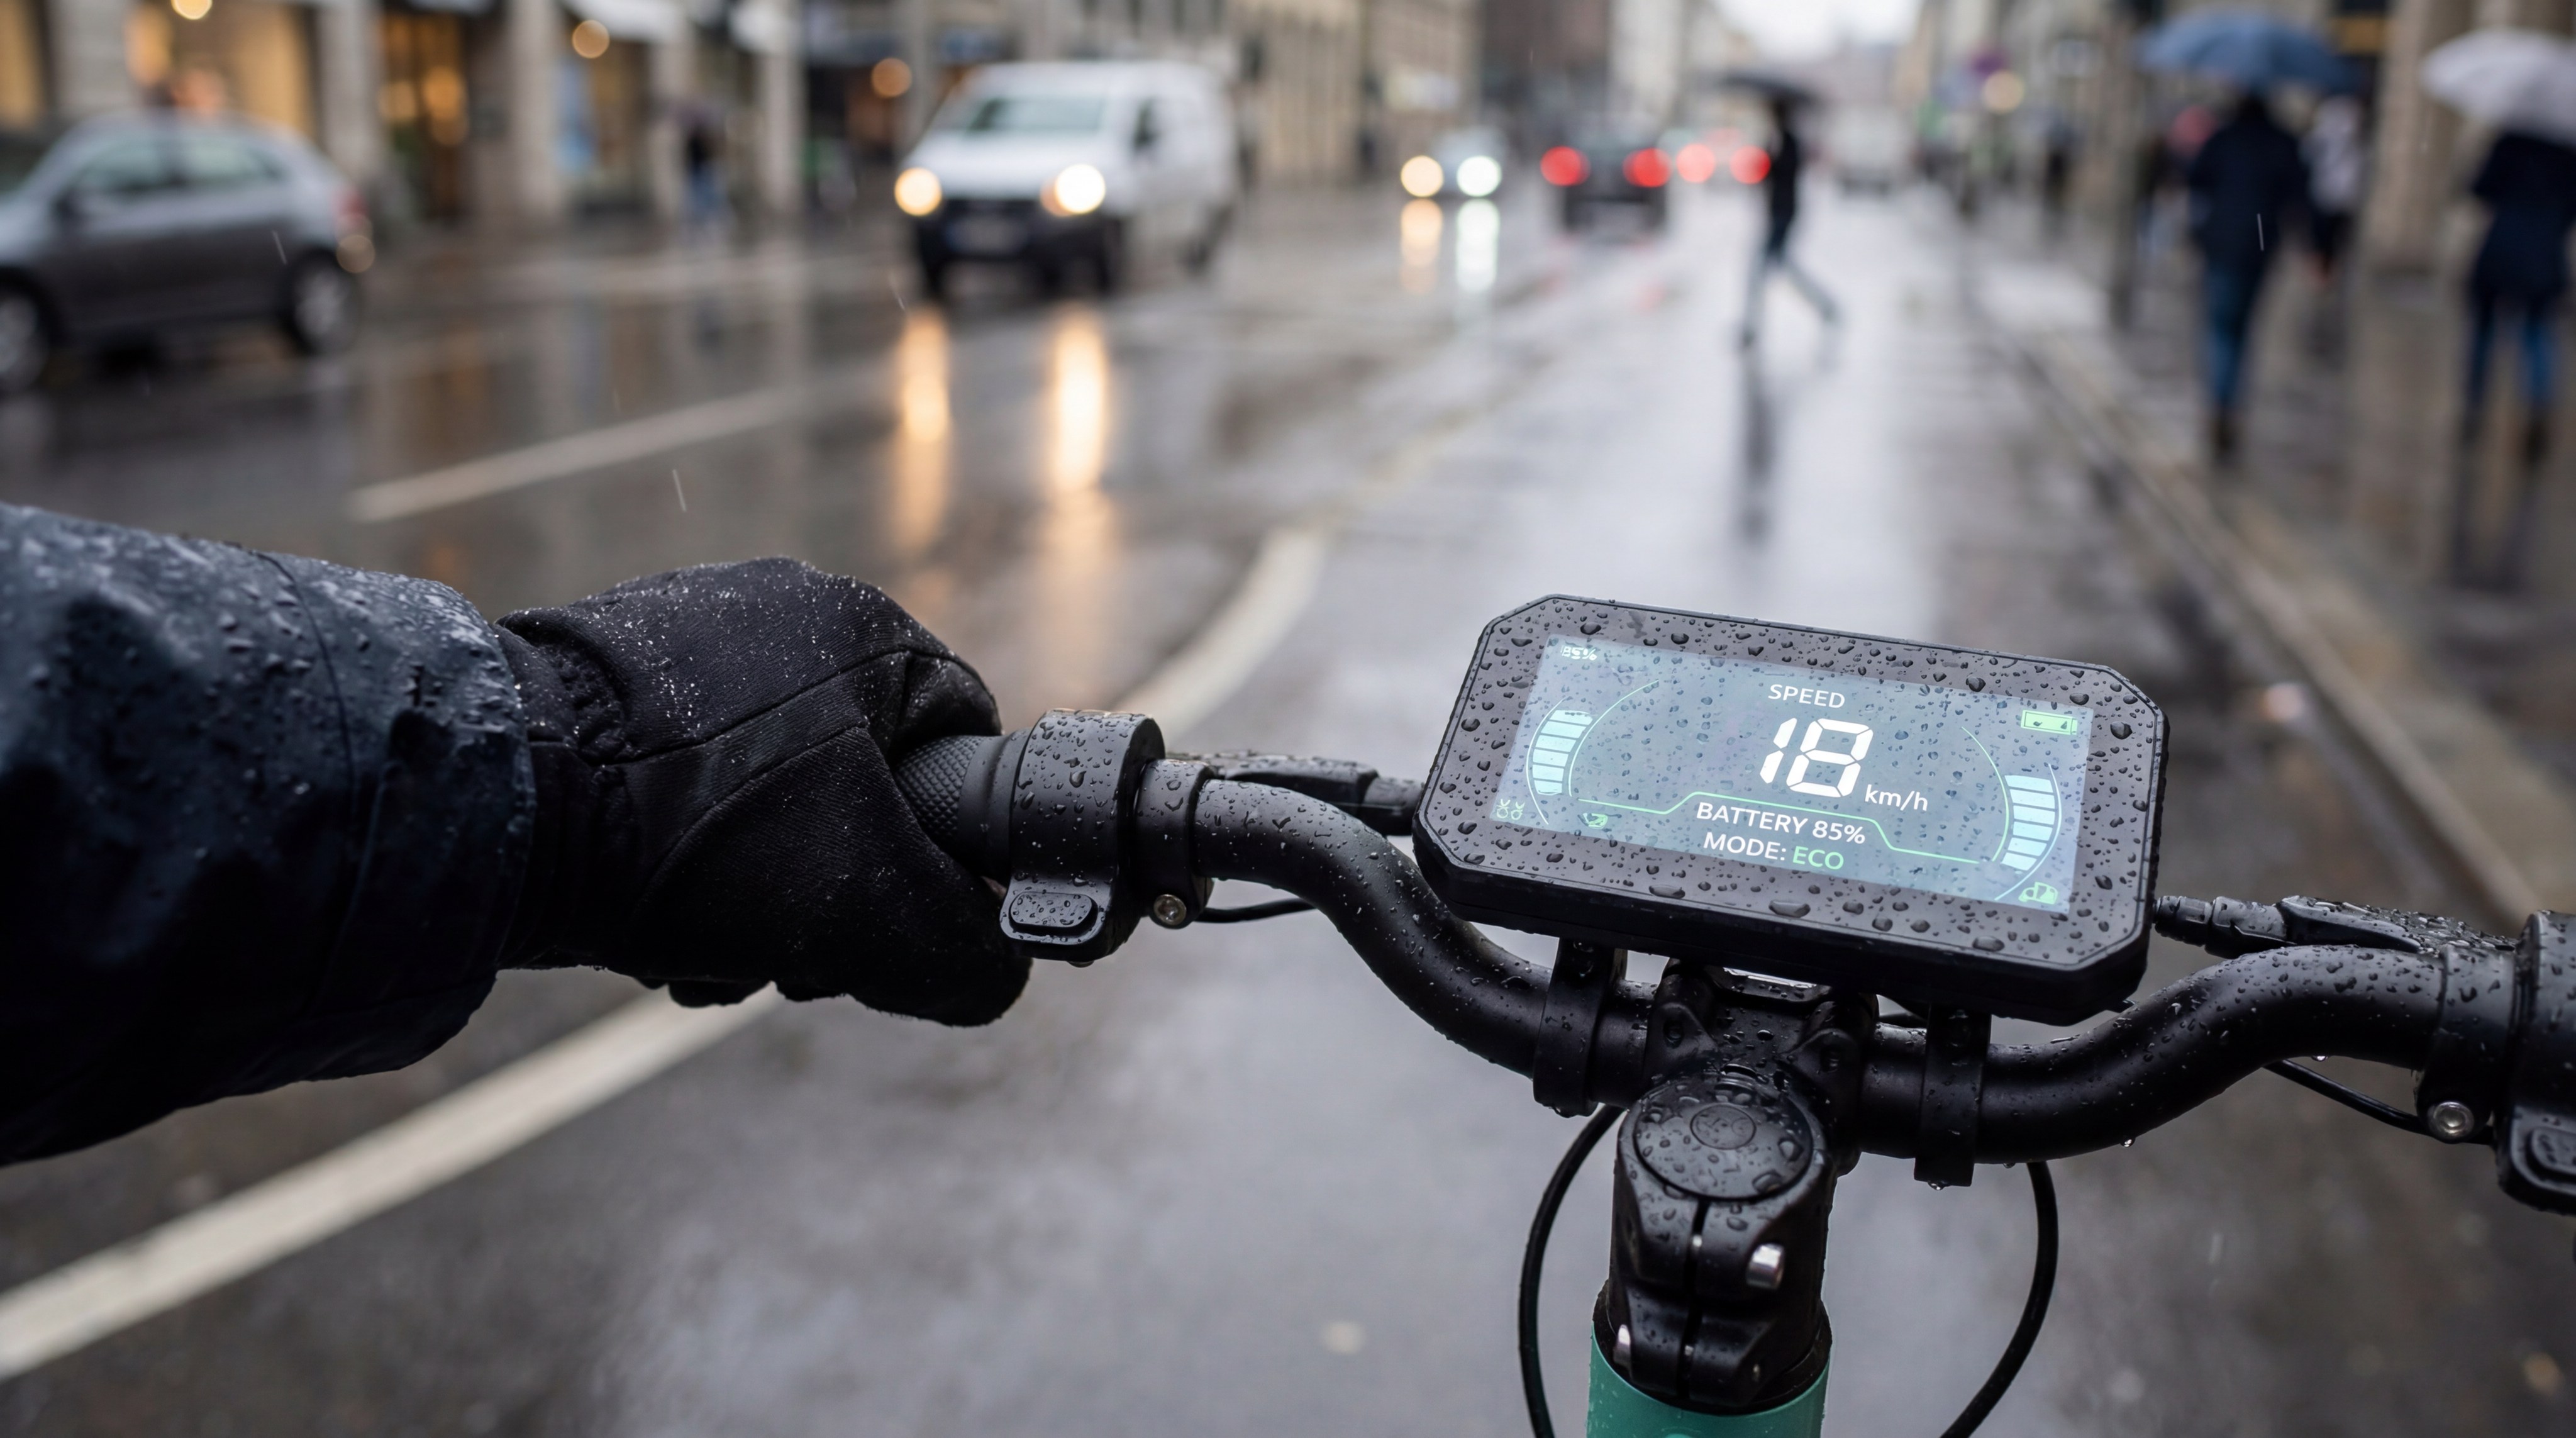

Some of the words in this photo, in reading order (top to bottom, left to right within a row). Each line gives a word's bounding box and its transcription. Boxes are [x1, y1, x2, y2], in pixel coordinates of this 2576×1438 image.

[1768, 684, 1845, 708] SPEED
[1760, 718, 1874, 798] 18
[1864, 784, 1928, 811] km/h
[1696, 802, 1809, 835] BATTERY
[1812, 820, 1865, 844] 85%
[1703, 832, 1787, 861] MODE:
[1792, 846, 1844, 870] ECO
